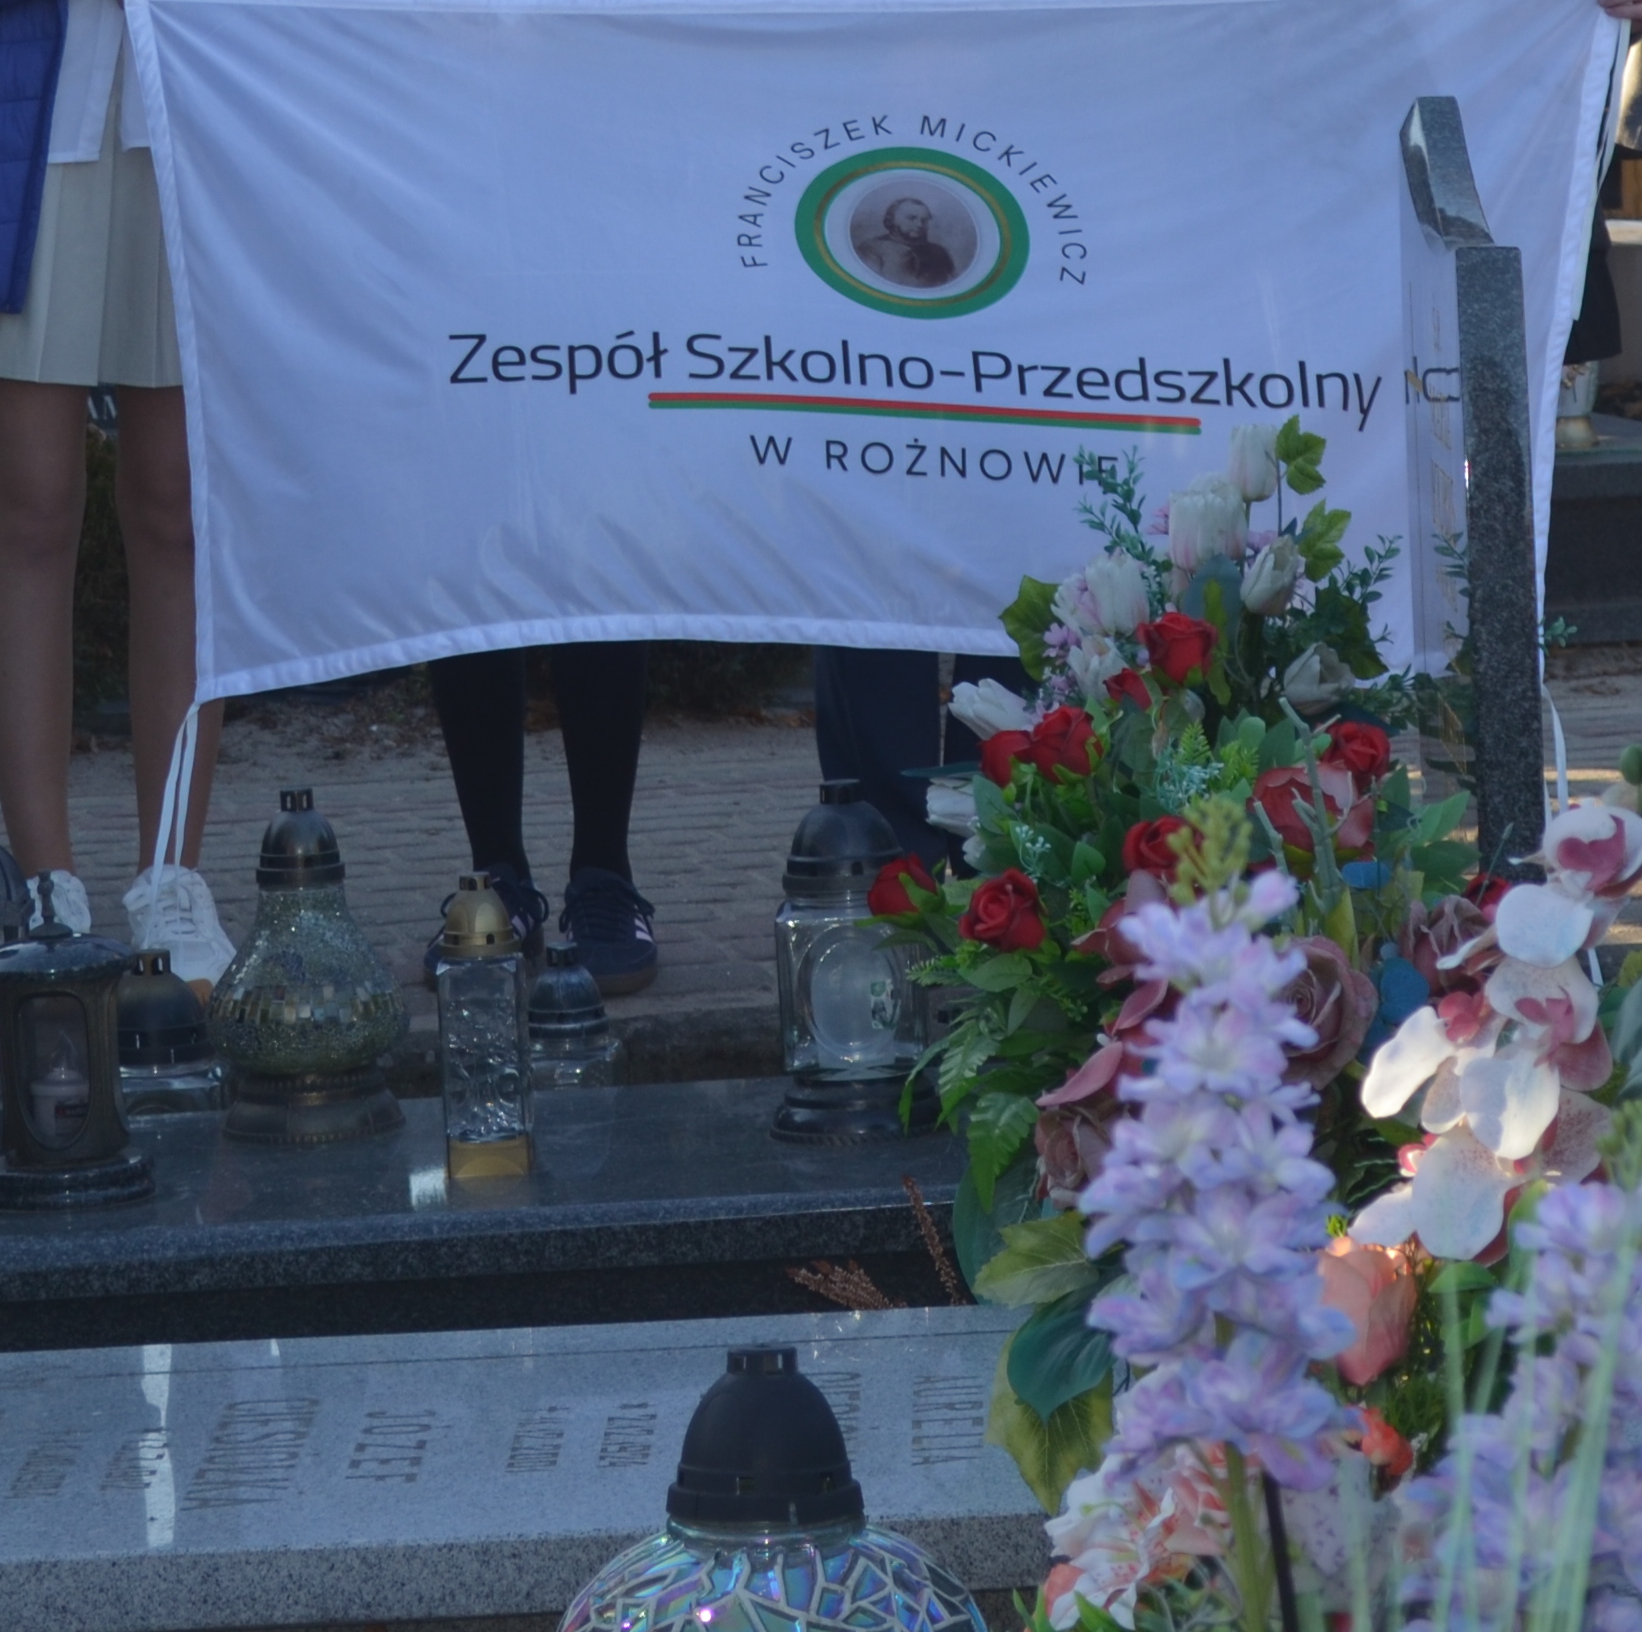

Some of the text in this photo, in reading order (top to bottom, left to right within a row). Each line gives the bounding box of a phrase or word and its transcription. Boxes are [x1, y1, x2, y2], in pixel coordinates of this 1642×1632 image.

[737, 115, 1088, 285] FRANCISZEK MICKIEWICZ
[448, 331, 668, 394] Zespół
[686, 334, 1382, 432] Szkolno-Przedszkolny
[750, 435, 793, 466] W
[345, 1410, 452, 1484] JÓZEF
[911, 1375, 984, 1466] AURELIA
